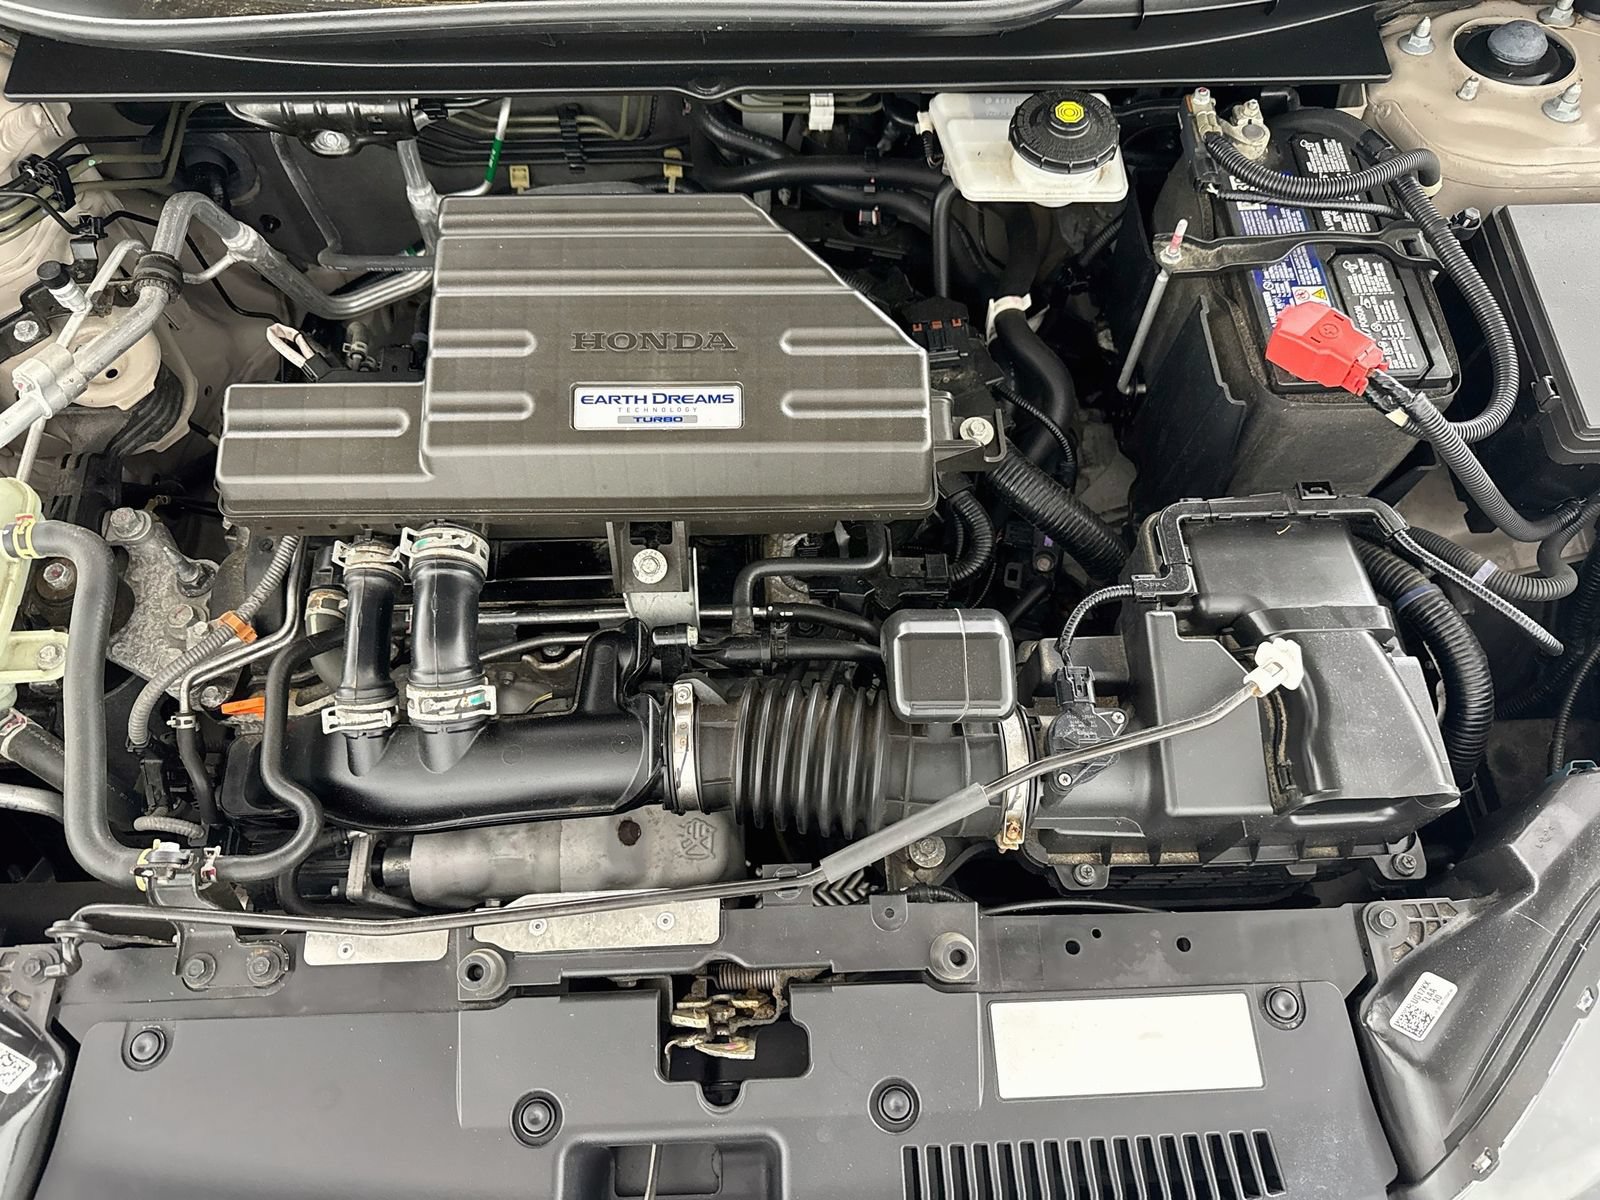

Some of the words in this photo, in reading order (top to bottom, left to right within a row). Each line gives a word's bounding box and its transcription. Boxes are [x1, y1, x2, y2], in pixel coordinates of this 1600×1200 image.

[571, 331, 738, 352] HONDA
[580, 394, 648, 405] EARTH
[652, 393, 735, 405] DREAMS
